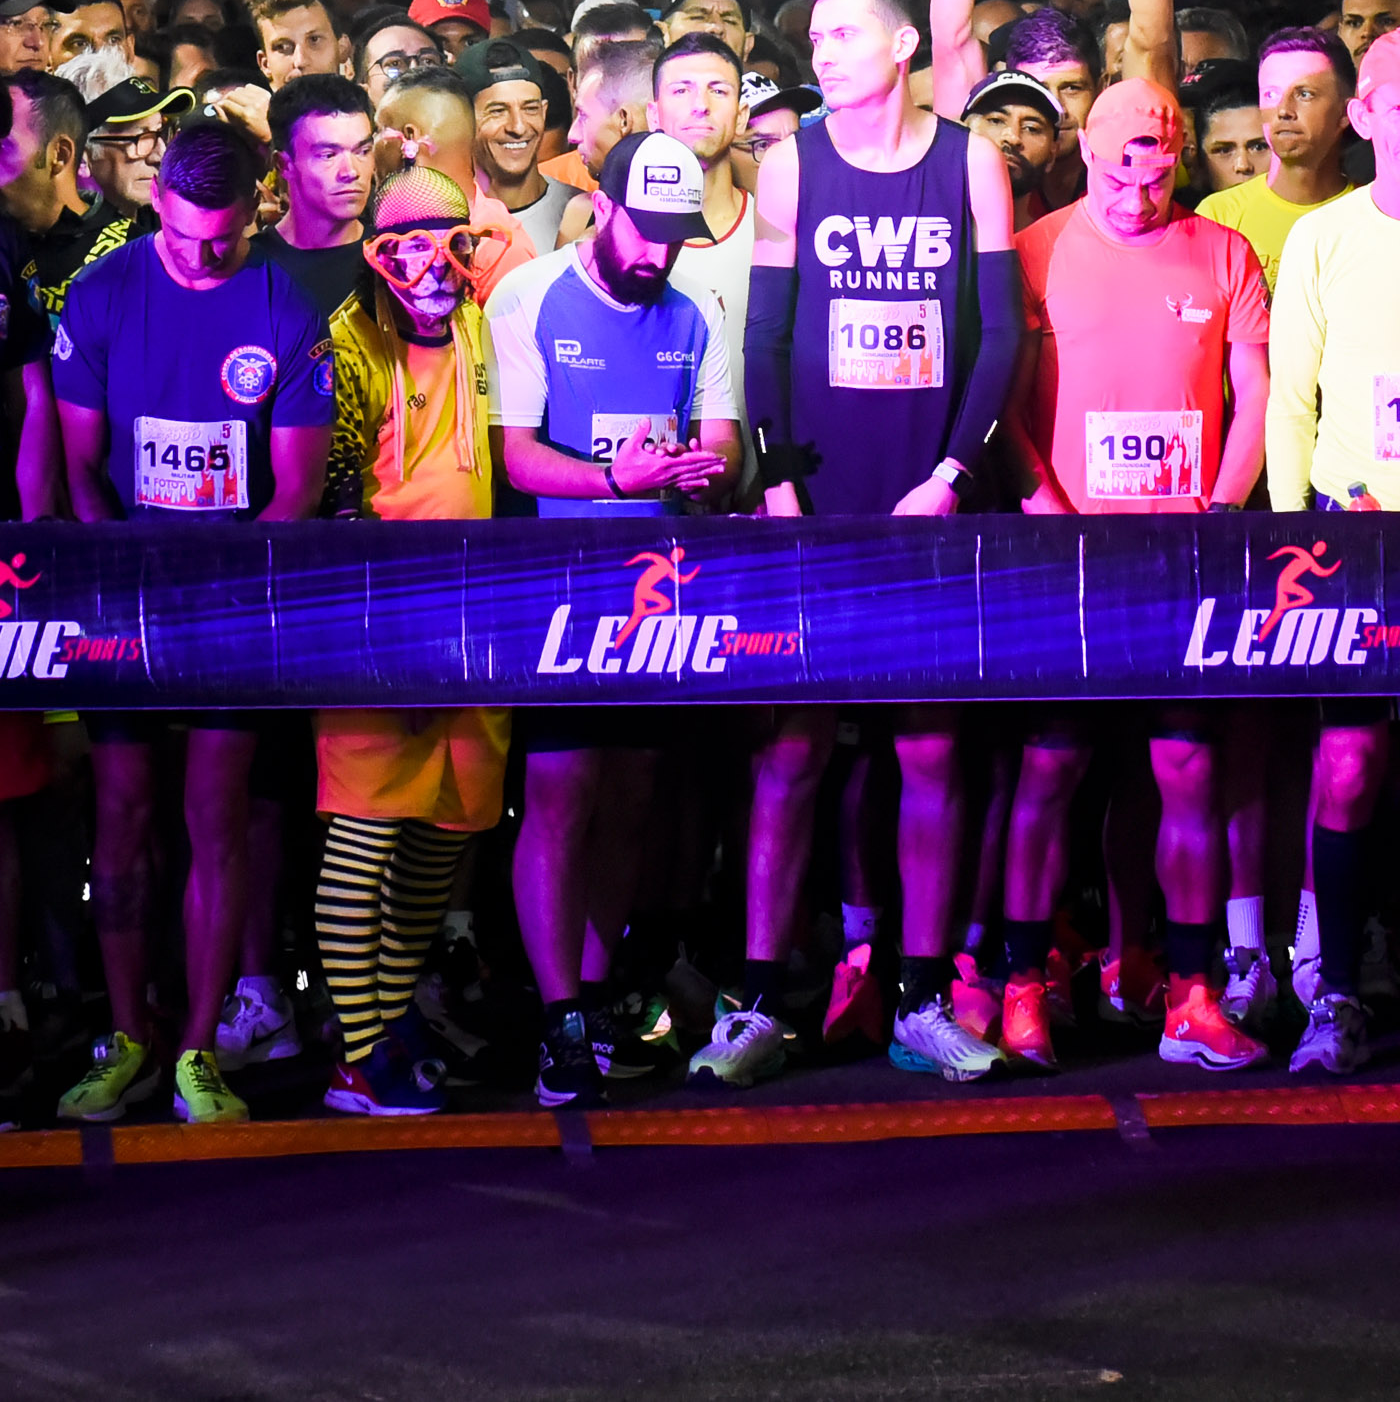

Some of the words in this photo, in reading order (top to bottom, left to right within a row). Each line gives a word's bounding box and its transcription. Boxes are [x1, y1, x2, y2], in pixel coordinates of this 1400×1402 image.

[814, 214, 952, 268] CWB
[829, 269, 937, 291] RUNNER
[840, 323, 926, 350] 1086
[143, 440, 229, 472] 1465
[1100, 435, 1165, 460] 190
[536, 604, 738, 673] LEME
[718, 631, 799, 656] SPORTS
[1183, 597, 1378, 666] LEME
[60, 638, 143, 661] SPORTS
